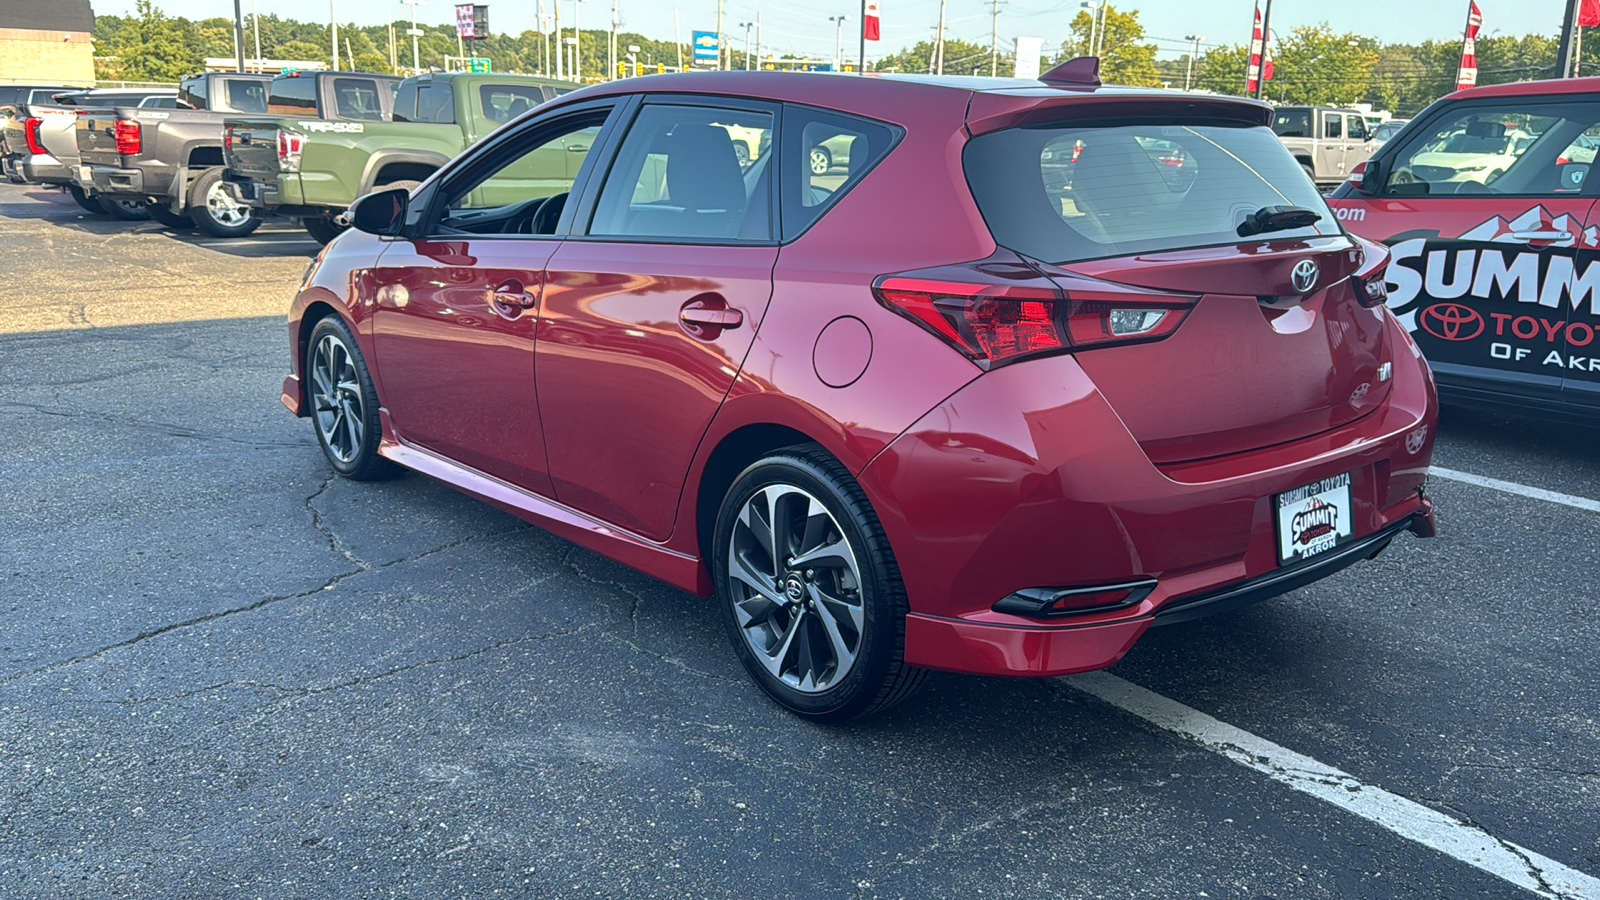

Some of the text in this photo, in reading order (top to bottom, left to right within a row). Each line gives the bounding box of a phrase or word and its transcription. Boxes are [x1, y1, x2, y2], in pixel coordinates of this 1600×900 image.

[1332, 207, 1366, 221] om
[1491, 342, 1532, 361] OF
[1280, 472, 1351, 508] SUMMIT TOYOTA
[1292, 505, 1337, 542] SUMMIT
[1302, 539, 1336, 559] AKRON
